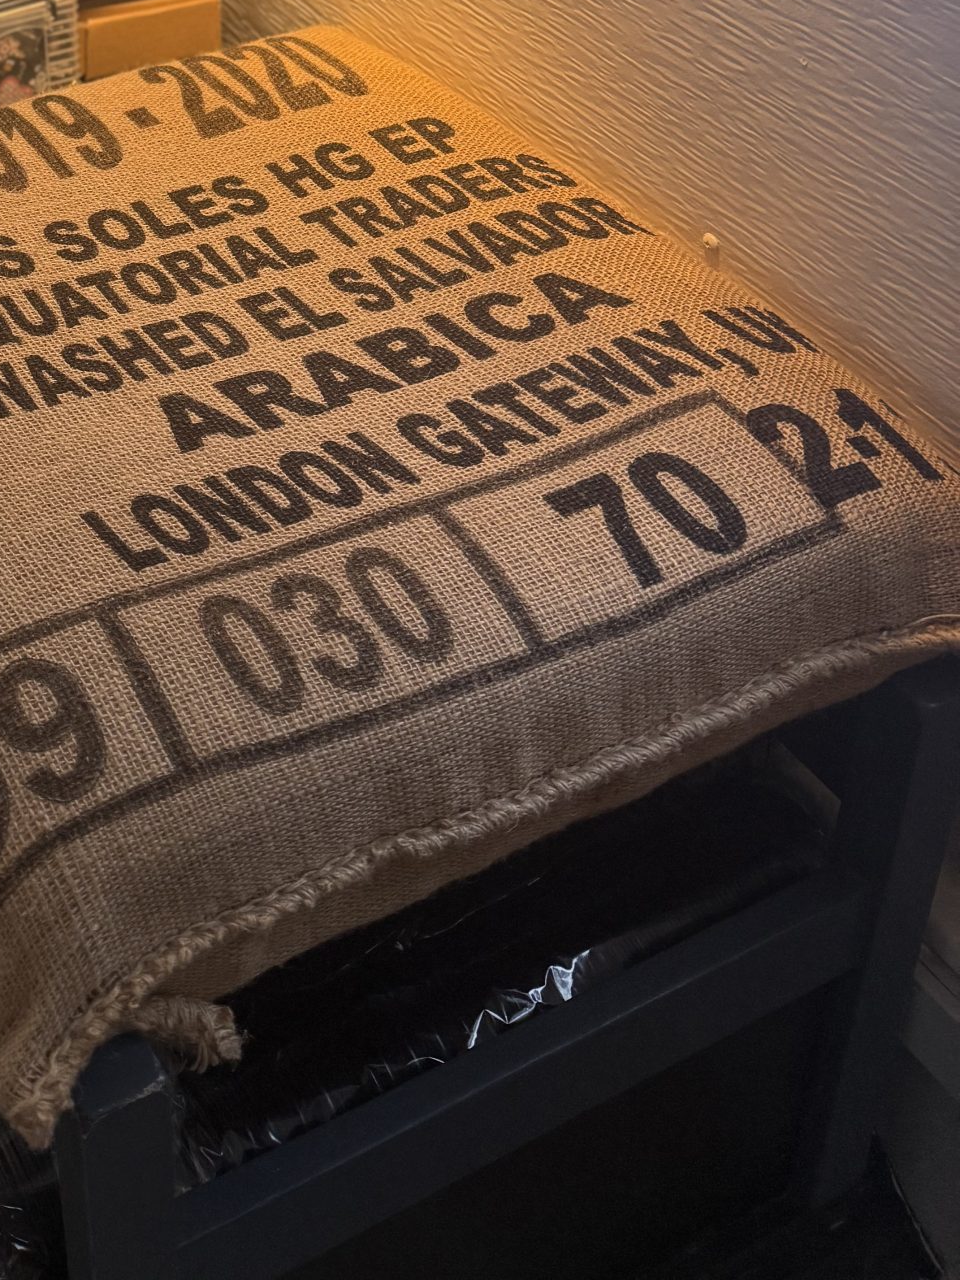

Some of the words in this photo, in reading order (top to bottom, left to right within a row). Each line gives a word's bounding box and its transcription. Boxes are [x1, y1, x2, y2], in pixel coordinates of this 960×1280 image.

[139, 35, 370, 140] 2020
[41, 173, 269, 263] SOLES
[265, 141, 376, 199] HG
[367, 116, 457, 166] EP
[299, 152, 578, 248] TRADERS
[240, 285, 345, 342] EL
[328, 196, 656, 313] SALVADOR
[157, 271, 634, 453] ARABICA
[81, 431, 424, 571] LONDON
[398, 319, 760, 469] GATEWAY,
[196, 546, 454, 717] 030
[542, 451, 748, 589] 70
